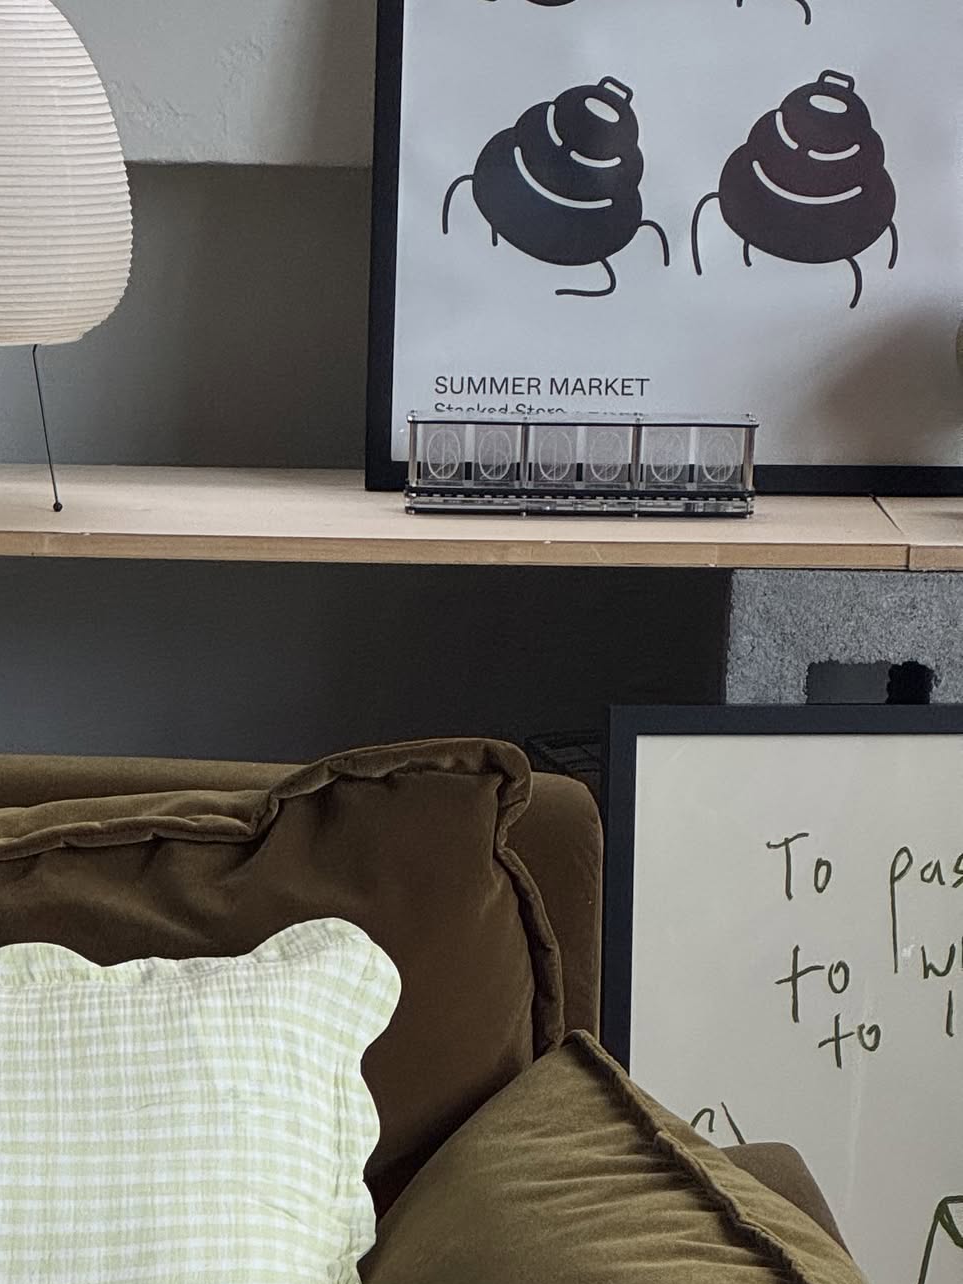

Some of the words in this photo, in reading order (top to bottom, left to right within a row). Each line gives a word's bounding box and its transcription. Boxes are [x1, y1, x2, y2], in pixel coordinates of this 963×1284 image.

[434, 376, 542, 396] SUMMER
[549, 377, 651, 397] MARKET
[766, 832, 832, 900] To
[774, 944, 850, 1023] to
[921, 935, 963, 979] w
[818, 1013, 881, 1069] to
